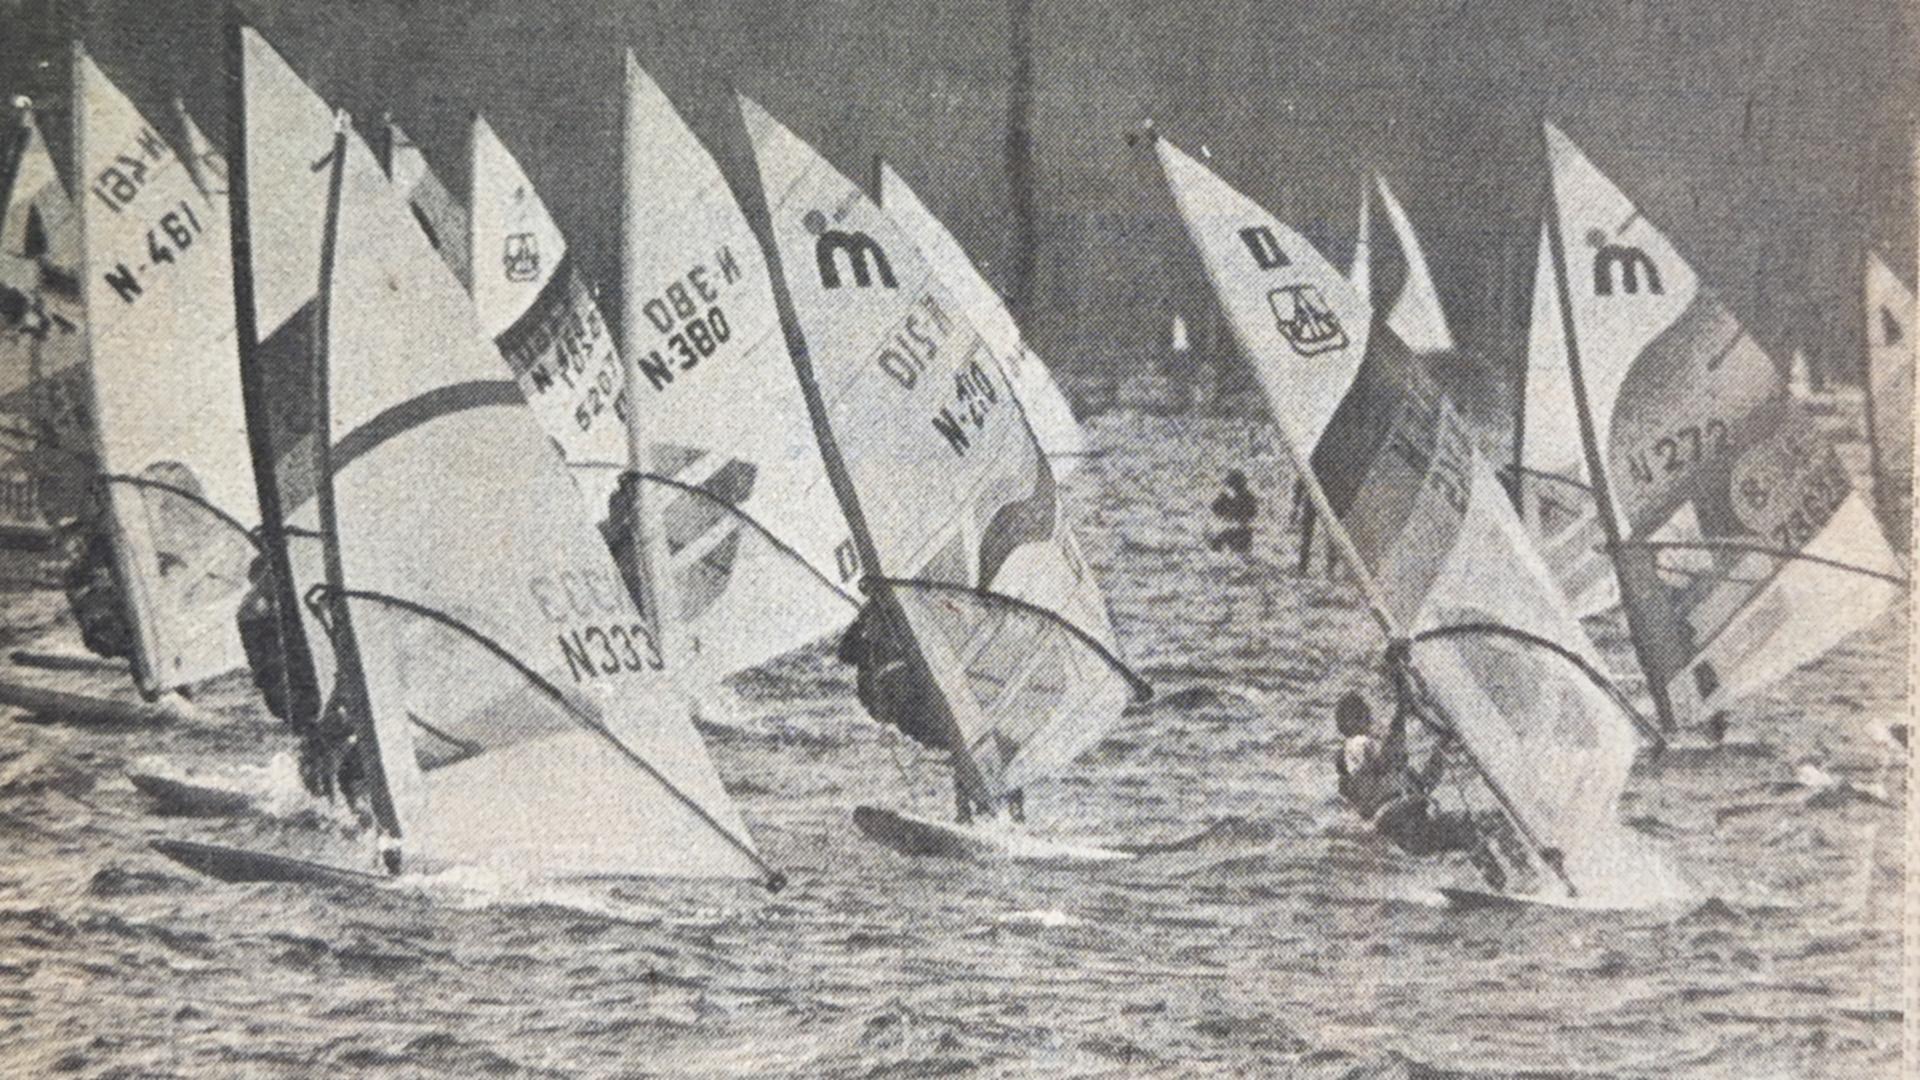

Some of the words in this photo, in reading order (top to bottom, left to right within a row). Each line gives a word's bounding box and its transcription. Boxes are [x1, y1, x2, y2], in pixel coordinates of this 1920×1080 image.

[104, 199, 202, 304] N-461
[638, 306, 730, 391] N-380
[557, 624, 665, 683] N333
